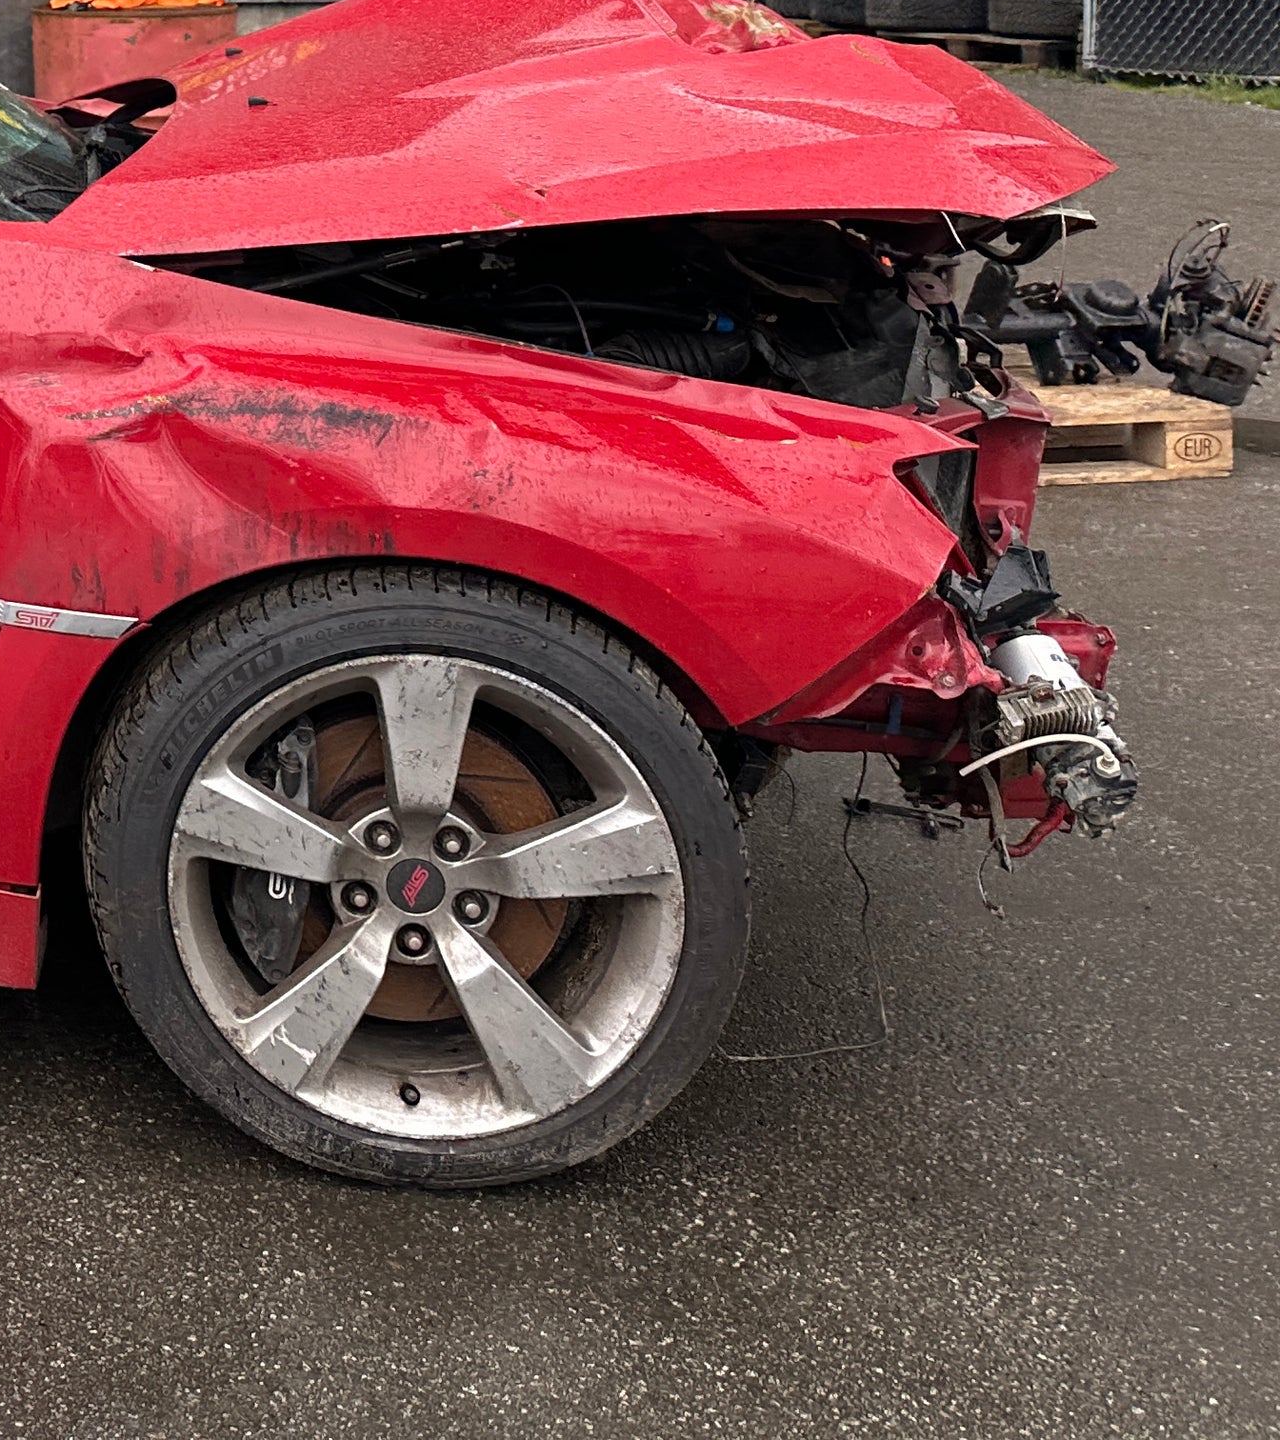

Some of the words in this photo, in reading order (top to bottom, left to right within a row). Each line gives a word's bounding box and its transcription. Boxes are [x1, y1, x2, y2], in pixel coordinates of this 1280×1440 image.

[1184, 437, 1213, 458] EUR
[338, 617, 386, 635] SPORT
[424, 617, 483, 635] SEASON
